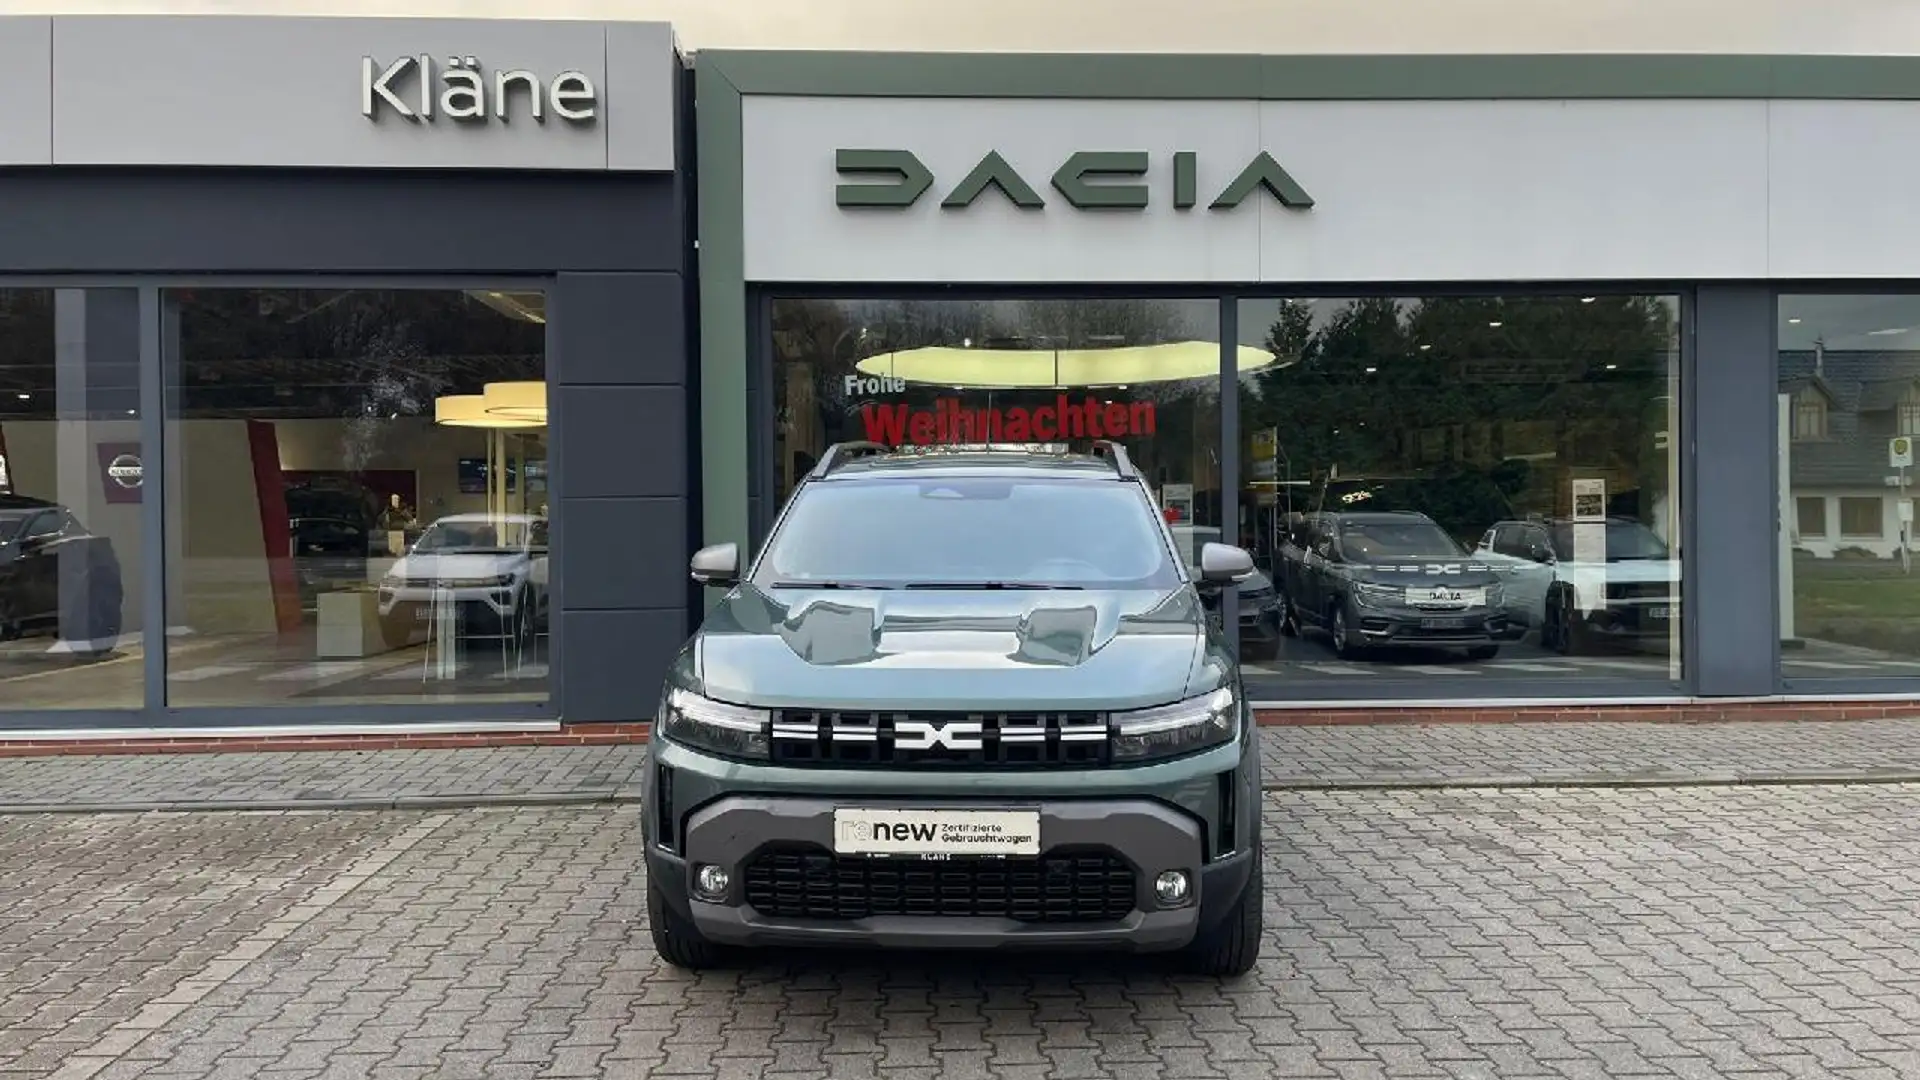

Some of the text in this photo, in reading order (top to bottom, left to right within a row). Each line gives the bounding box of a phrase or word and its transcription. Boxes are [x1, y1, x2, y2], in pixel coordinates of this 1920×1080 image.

[361, 53, 597, 124] Kläne
[836, 149, 1316, 210] DACIA
[845, 374, 906, 396] Frohe
[862, 395, 1156, 445] Weihnachten
[941, 833, 1032, 845] Gebrauchtwagen
